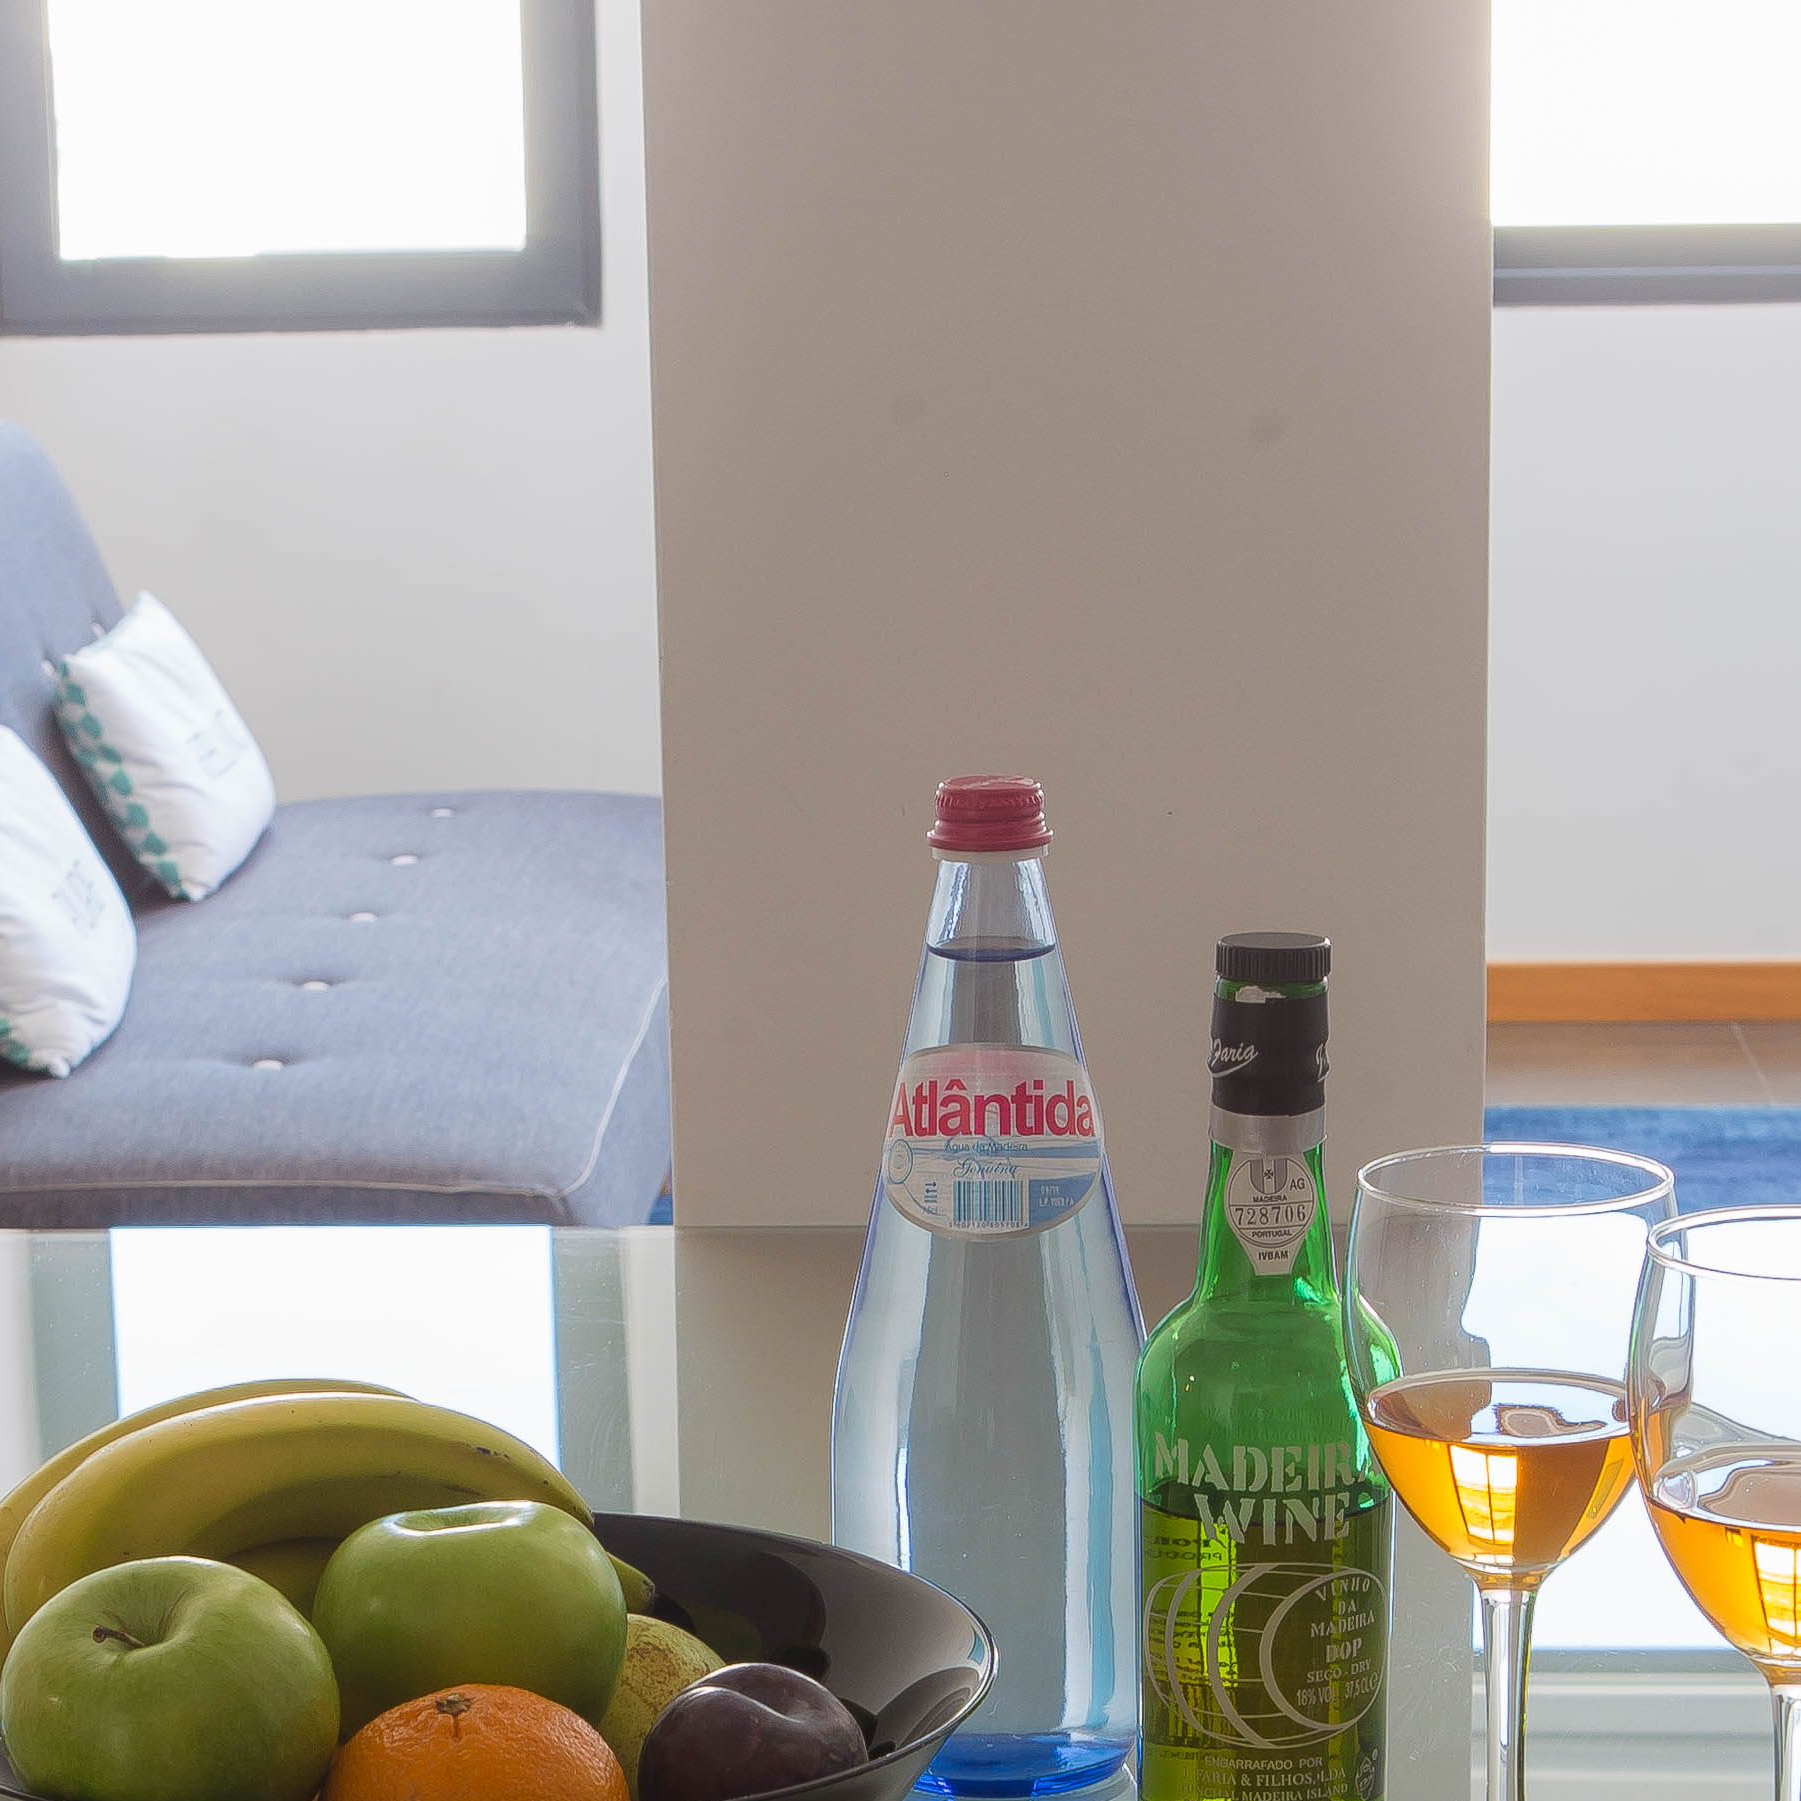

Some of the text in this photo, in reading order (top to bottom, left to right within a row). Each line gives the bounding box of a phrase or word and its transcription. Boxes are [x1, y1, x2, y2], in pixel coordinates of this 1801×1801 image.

[888, 1078, 1096, 1138] Atlântida
[1289, 1178, 1306, 1192] AG
[1235, 1204, 1306, 1226] 728706
[1251, 1229, 1293, 1239] PORTUGAL
[1258, 1250, 1289, 1261] IVBAM
[1194, 1492, 1350, 1545] WINE
[1315, 1577, 1370, 1601] VINHO
[1338, 1599, 1357, 1616] DA
[1310, 1610, 1376, 1637] MADEIRA
[1326, 1638, 1363, 1663] DOP
[1306, 1658, 1372, 1683] SECO DRY
[1296, 1688, 1317, 1706] 18%
[1204, 1756, 1323, 1771] ENGARRAFADO POR
[1196, 1769, 1237, 1785] FARIA
[1240, 1773, 1251, 1787] &
[1241, 1790, 1302, 1801] MADEIRA
[1306, 1784, 1348, 1799] ISLAND
